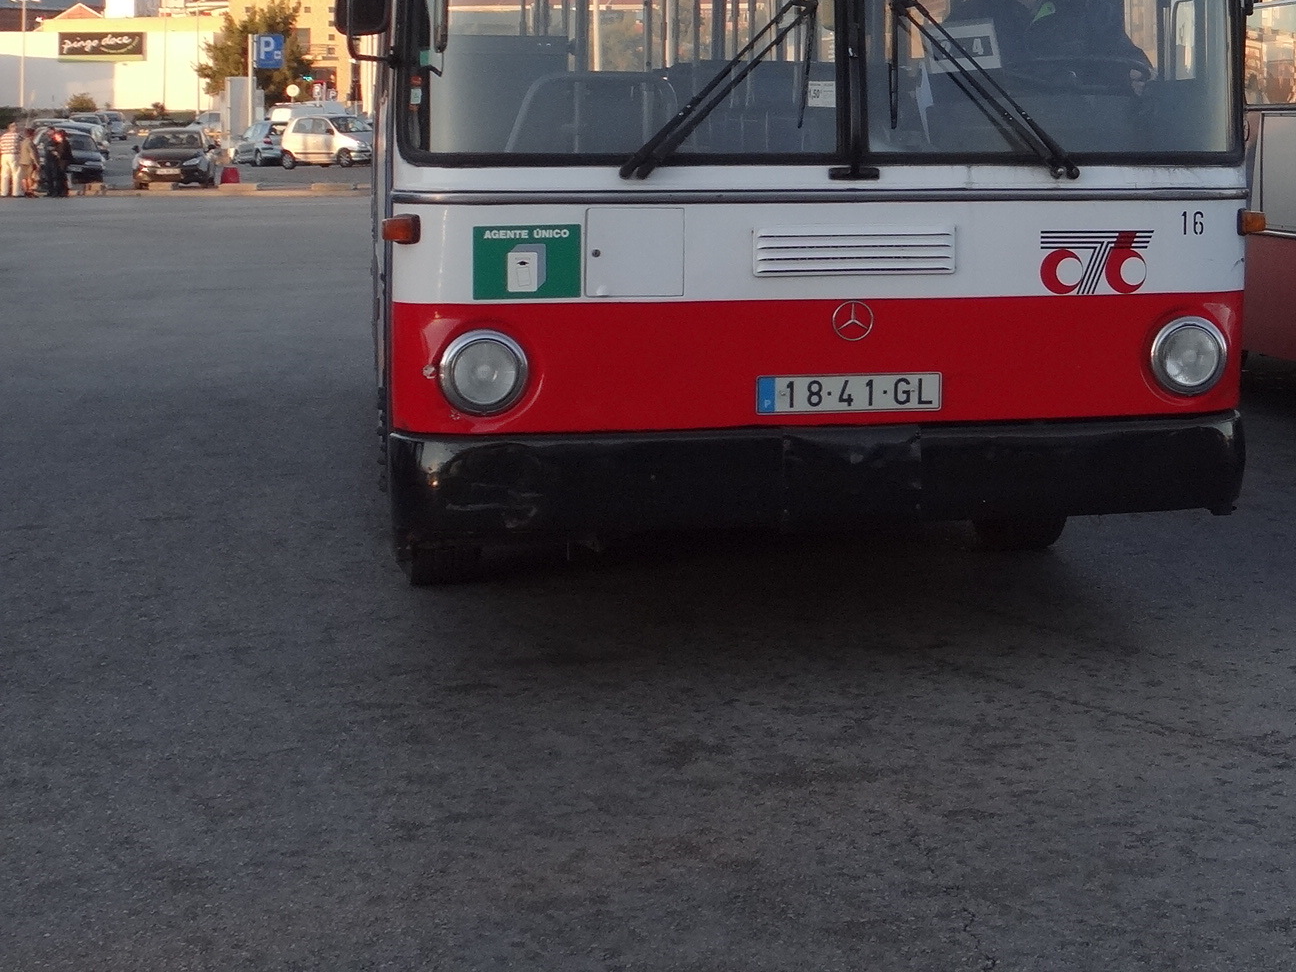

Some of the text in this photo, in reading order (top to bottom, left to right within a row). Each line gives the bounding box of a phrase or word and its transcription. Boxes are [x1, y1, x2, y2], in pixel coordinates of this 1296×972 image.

[61, 37, 99, 54] pingo
[101, 34, 132, 46] doce
[260, 36, 275, 60] P
[483, 229, 570, 239] AGENTE ÚNICO
[1180, 211, 1204, 235] 16
